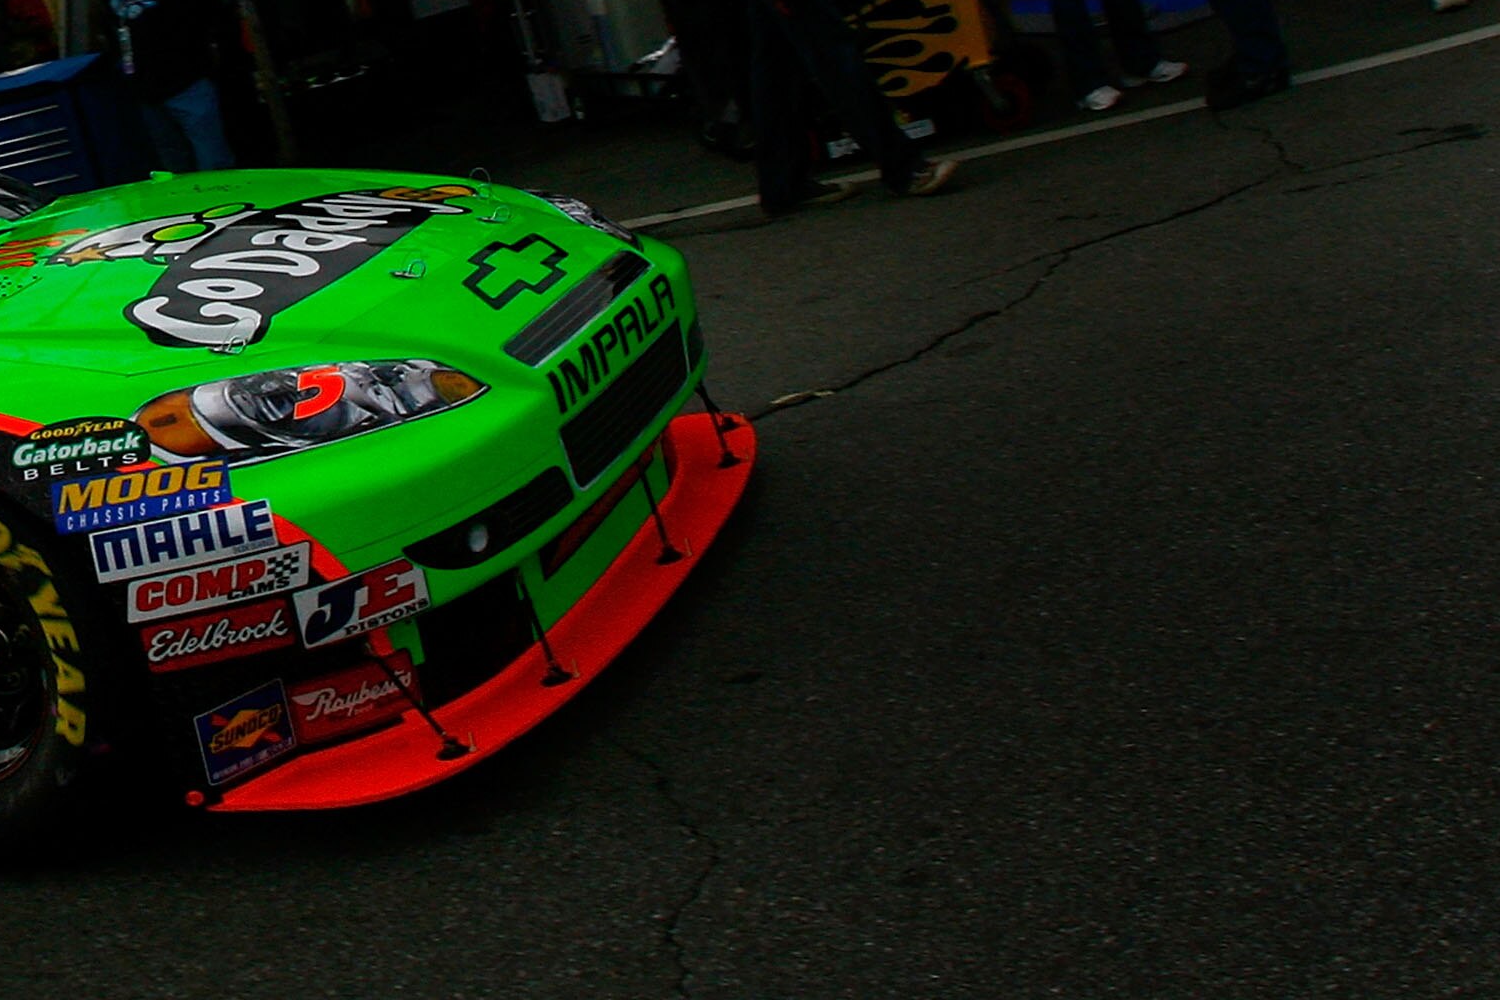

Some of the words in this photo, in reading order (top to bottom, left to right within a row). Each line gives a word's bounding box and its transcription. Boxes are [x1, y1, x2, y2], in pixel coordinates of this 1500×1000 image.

[546, 273, 675, 414] IMPALA
[293, 366, 345, 420] 5
[13, 431, 141, 466] Gatorback
[24, 453, 139, 480] BELTS
[58, 460, 224, 514] MOOG
[67, 502, 146, 530] CHASSIS
[162, 490, 221, 512] PARTS
[93, 501, 273, 573] MAHLE
[136, 559, 266, 612] COMP
[227, 577, 290, 601] CAMS
[305, 558, 415, 646] JE
[148, 609, 289, 662] Edelbrock
[344, 598, 429, 636] PISTONS
[208, 703, 284, 755] SUNOCO
